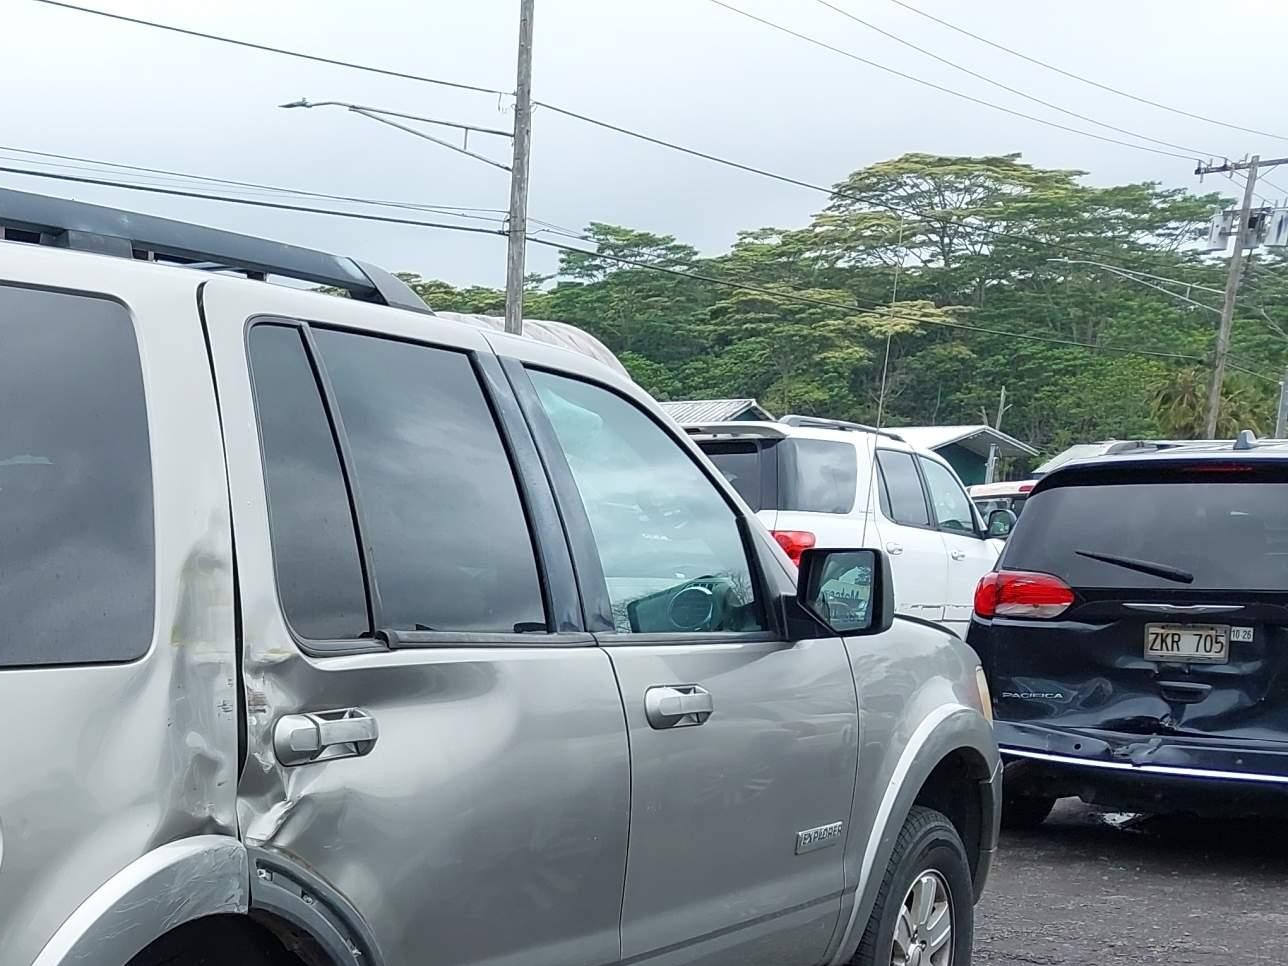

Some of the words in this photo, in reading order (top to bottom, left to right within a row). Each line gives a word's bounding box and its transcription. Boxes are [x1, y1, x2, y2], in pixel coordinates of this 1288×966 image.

[1149, 632, 1181, 652] ZKR
[1193, 633, 1224, 653] 705
[1232, 629, 1240, 639] 10
[801, 824, 843, 846] EXPLORER
